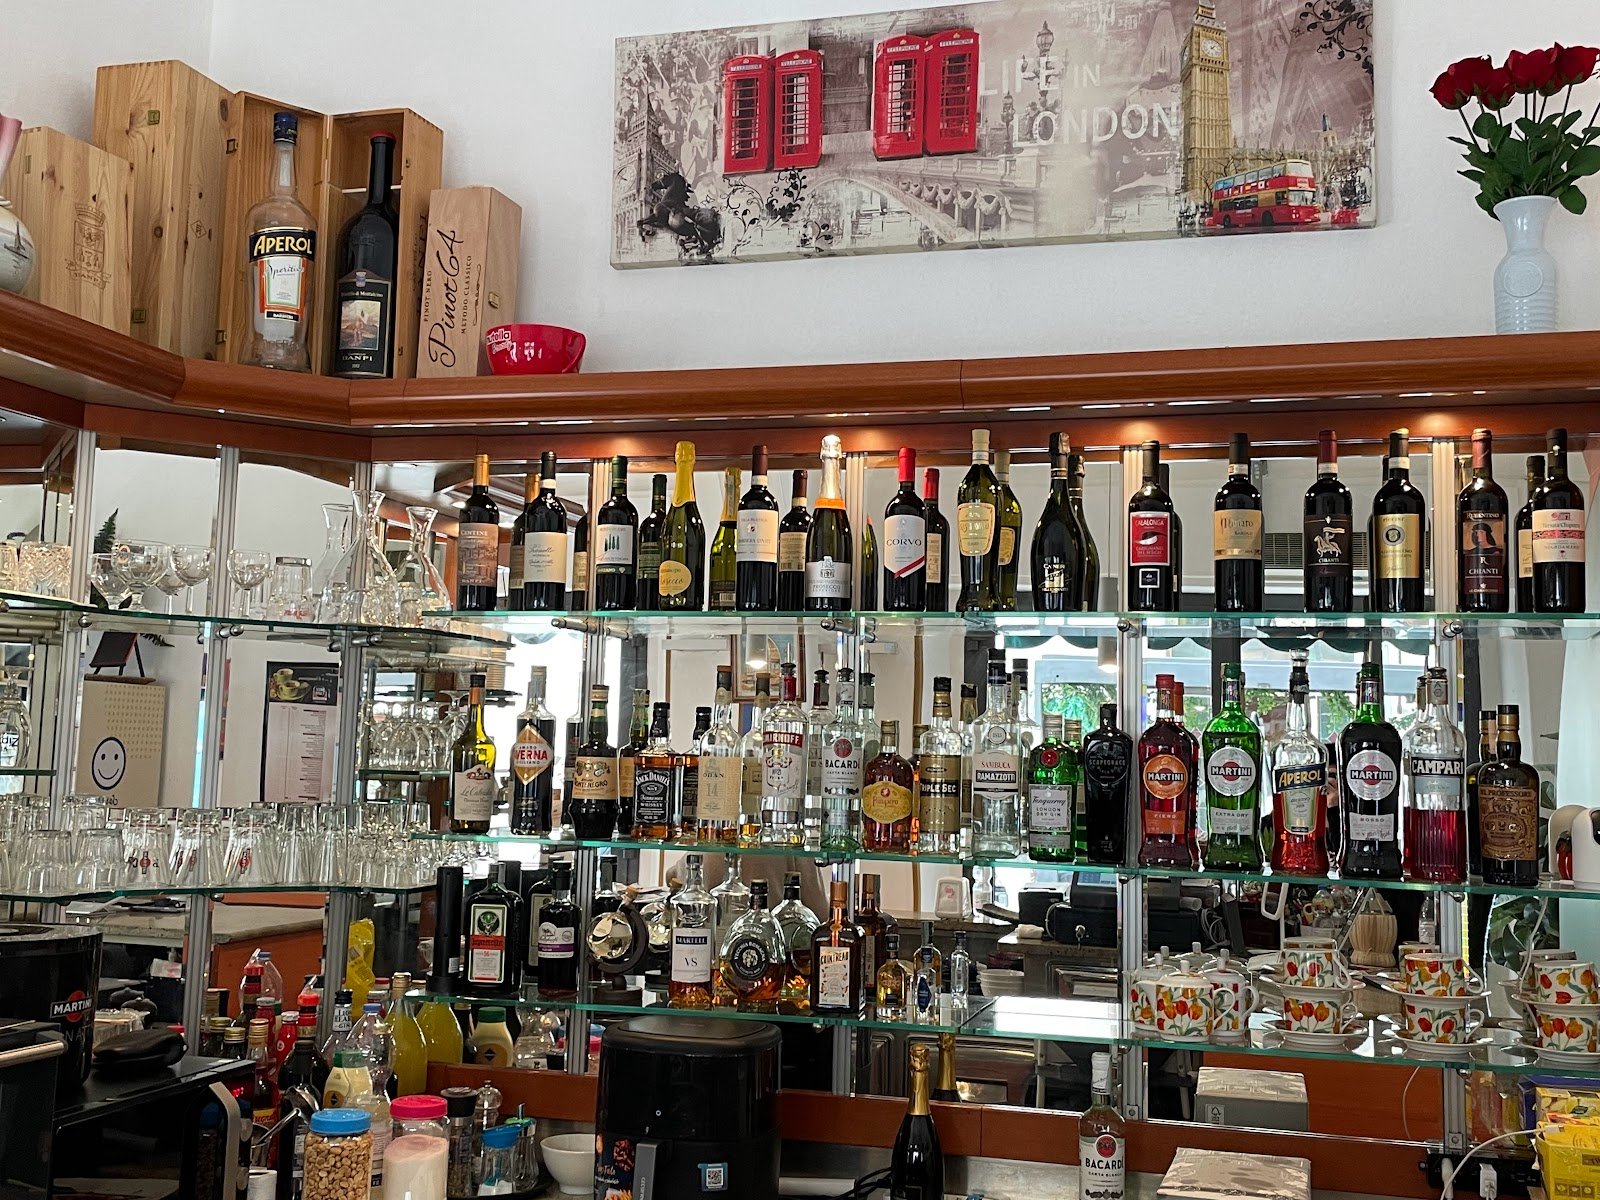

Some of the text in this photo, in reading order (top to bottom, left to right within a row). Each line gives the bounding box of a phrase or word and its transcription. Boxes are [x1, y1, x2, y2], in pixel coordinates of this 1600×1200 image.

[979, 55, 1101, 97] LIFE IN
[1012, 101, 1180, 149] LONDON
[253, 234, 313, 257] APEROL
[464, 255, 472, 296] CLASSICO
[423, 293, 431, 322] PINOT
[886, 538, 923, 546] CORVO
[1480, 556, 1489, 565] R
[981, 761, 1011, 769] SAMBUCA
[1211, 766, 1251, 776] MARTINI
[1411, 759, 1464, 775] CAMPARI
[635, 774, 649, 786] JACK
[1147, 773, 1184, 781] MARTINI
[1278, 768, 1322, 788] APEROL
[1350, 770, 1392, 780] MARTINI
[706, 783, 718, 797] 14
[920, 783, 956, 793] TRIPLE SEC
[1032, 795, 1067, 807] Tanqueray
[684, 957, 698, 967] VS
[820, 951, 849, 965] COINTREAU
